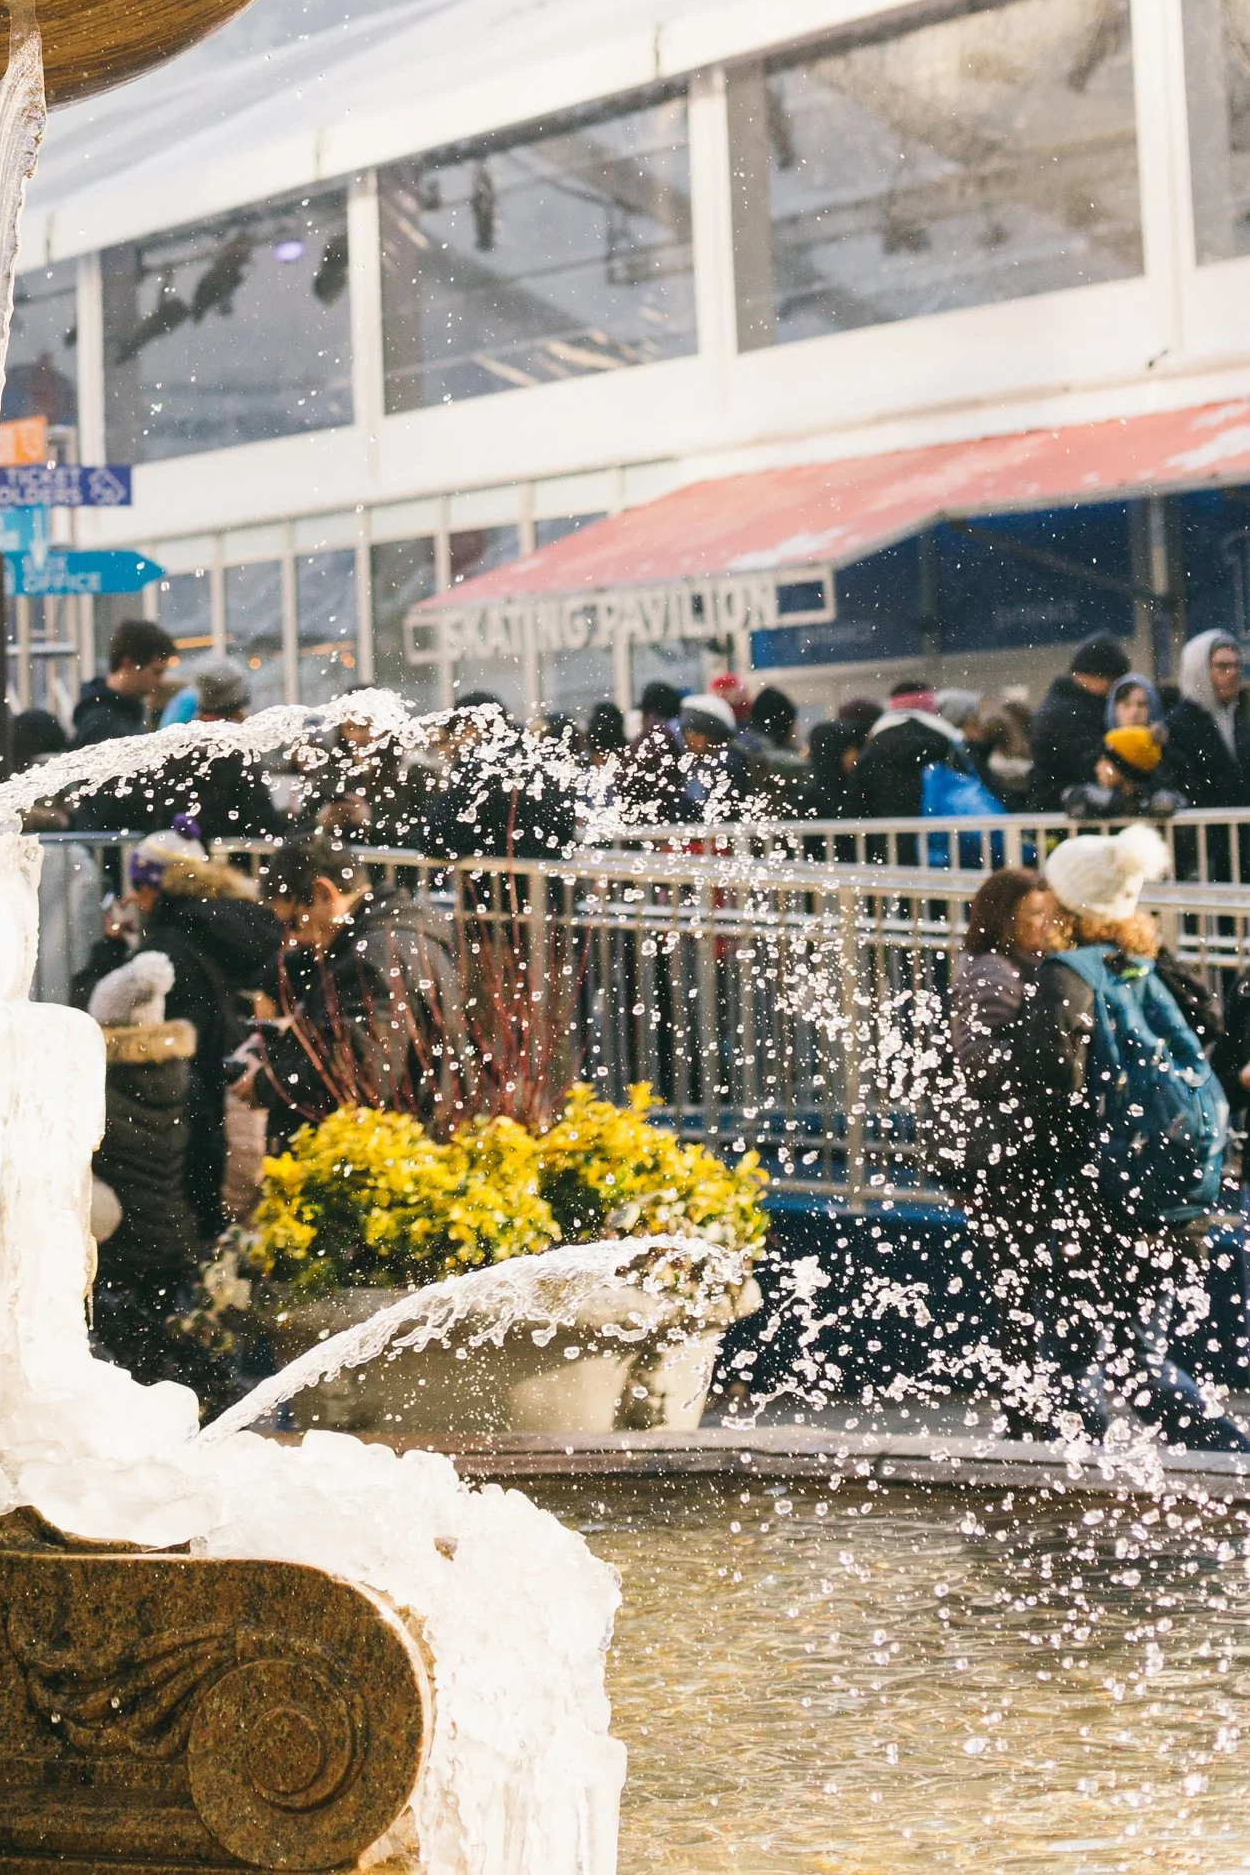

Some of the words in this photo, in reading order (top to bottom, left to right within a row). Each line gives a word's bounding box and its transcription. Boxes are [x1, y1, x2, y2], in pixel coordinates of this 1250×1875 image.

[5, 466, 81, 486] TICKET
[22, 571, 102, 593] OFFICE
[447, 597, 594, 660] SKATING
[596, 573, 778, 648] PAVILION
